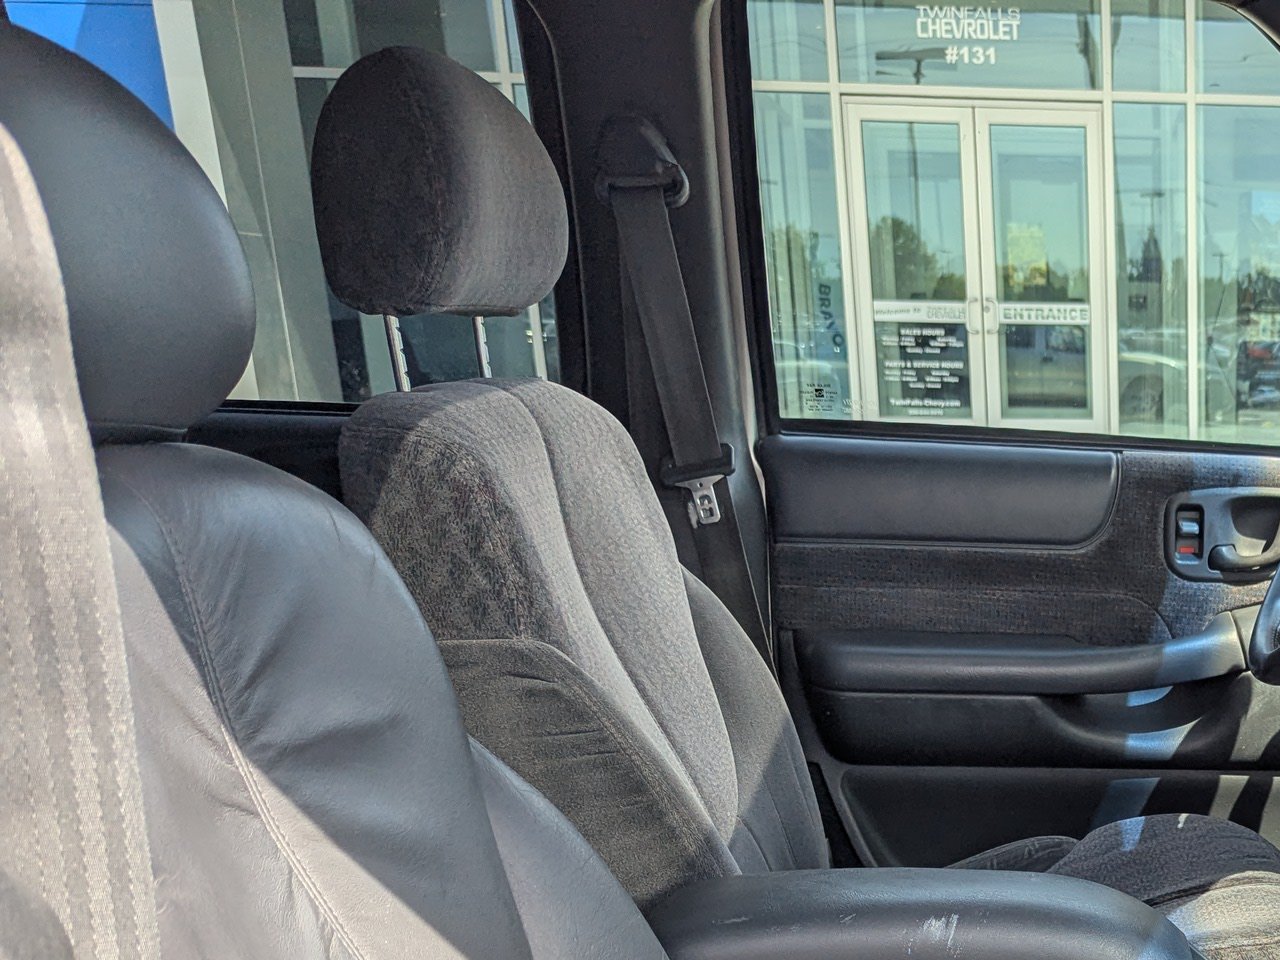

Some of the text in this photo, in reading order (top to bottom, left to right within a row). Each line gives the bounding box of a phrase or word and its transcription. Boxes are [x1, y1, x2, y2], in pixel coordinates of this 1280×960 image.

[916, 18, 1021, 40] CHEVROLET
[944, 46, 996, 65] #131
[1002, 307, 1089, 321] ENTRANCE
